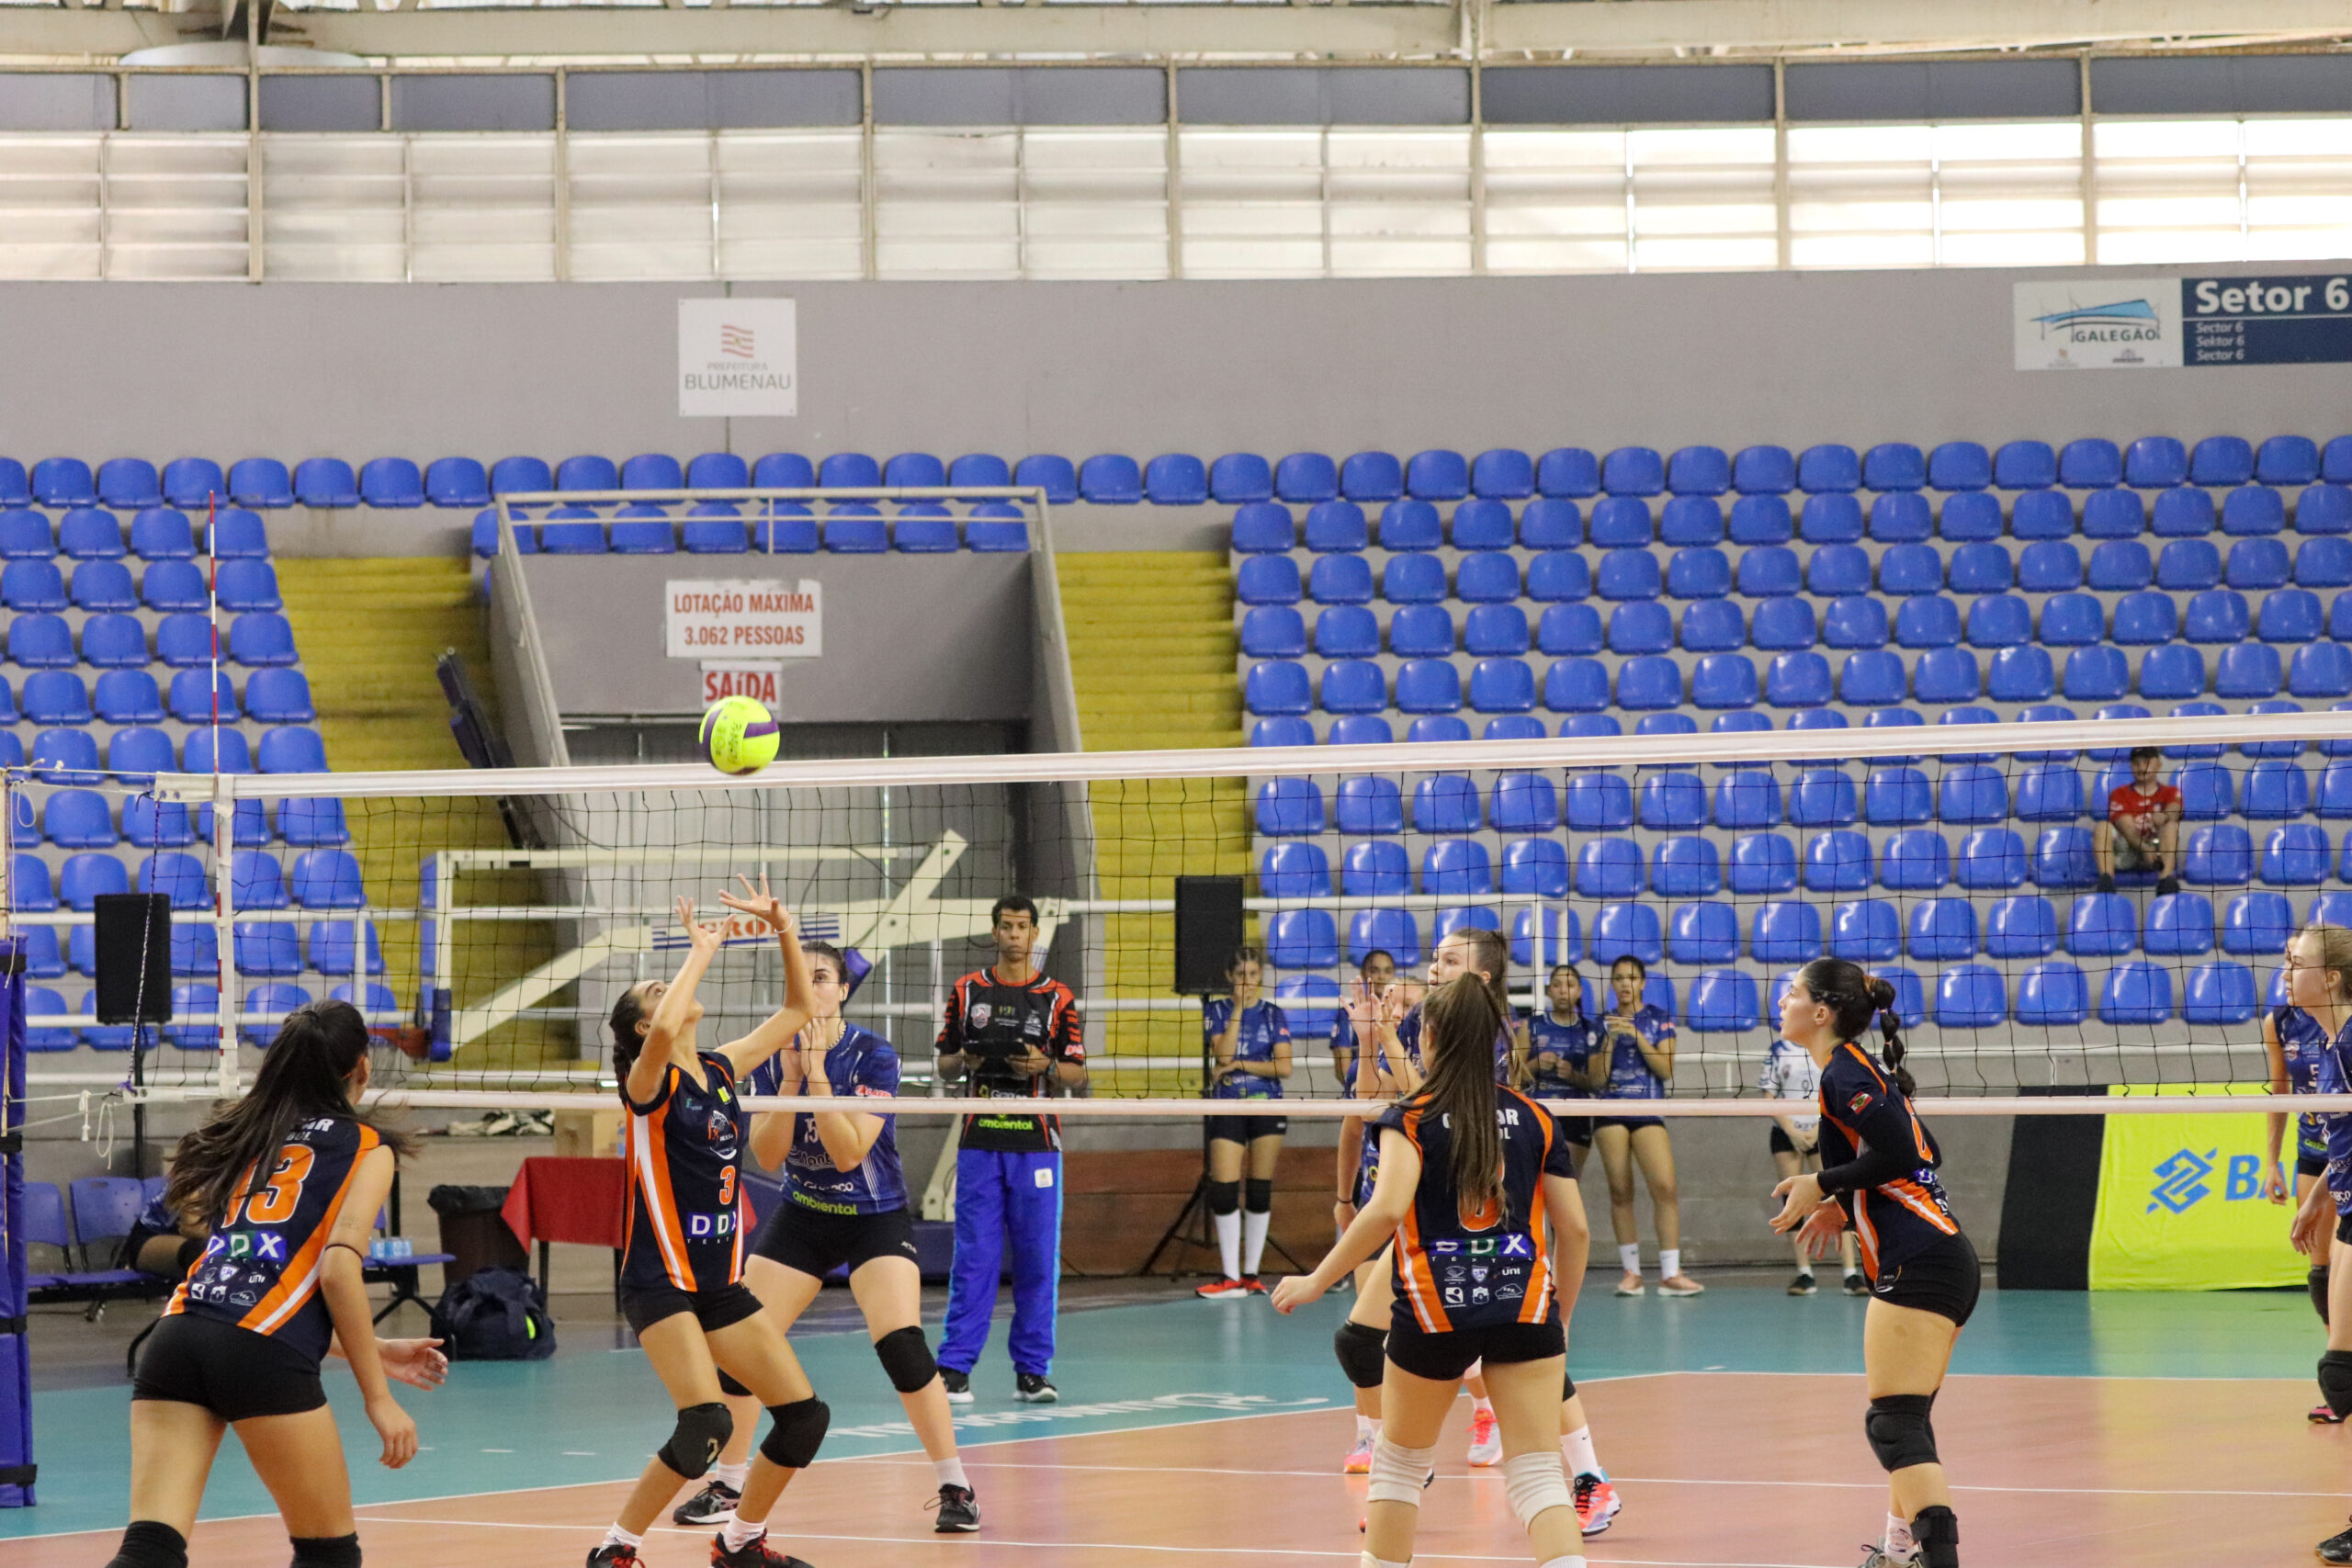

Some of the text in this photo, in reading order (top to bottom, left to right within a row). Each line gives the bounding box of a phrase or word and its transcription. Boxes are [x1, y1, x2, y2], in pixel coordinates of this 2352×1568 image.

[2195, 277, 2350, 314] Setor 6
[2075, 328, 2156, 344] GALEGÃO
[2234, 321, 2245, 333] 6
[2236, 334, 2245, 347] 6
[2235, 348, 2245, 361] 6
[707, 362, 768, 372] PREFEITURA
[684, 373, 792, 390] BLUMENAU
[673, 589, 815, 618] LOTAÇÃO MÁXIMA
[684, 626, 805, 646] 3.062 PESSOAS
[220, 1143, 315, 1229] 13
[718, 1165, 736, 1206] 3
[792, 1190, 859, 1215] ambiental
[207, 1233, 282, 1258] DDX
